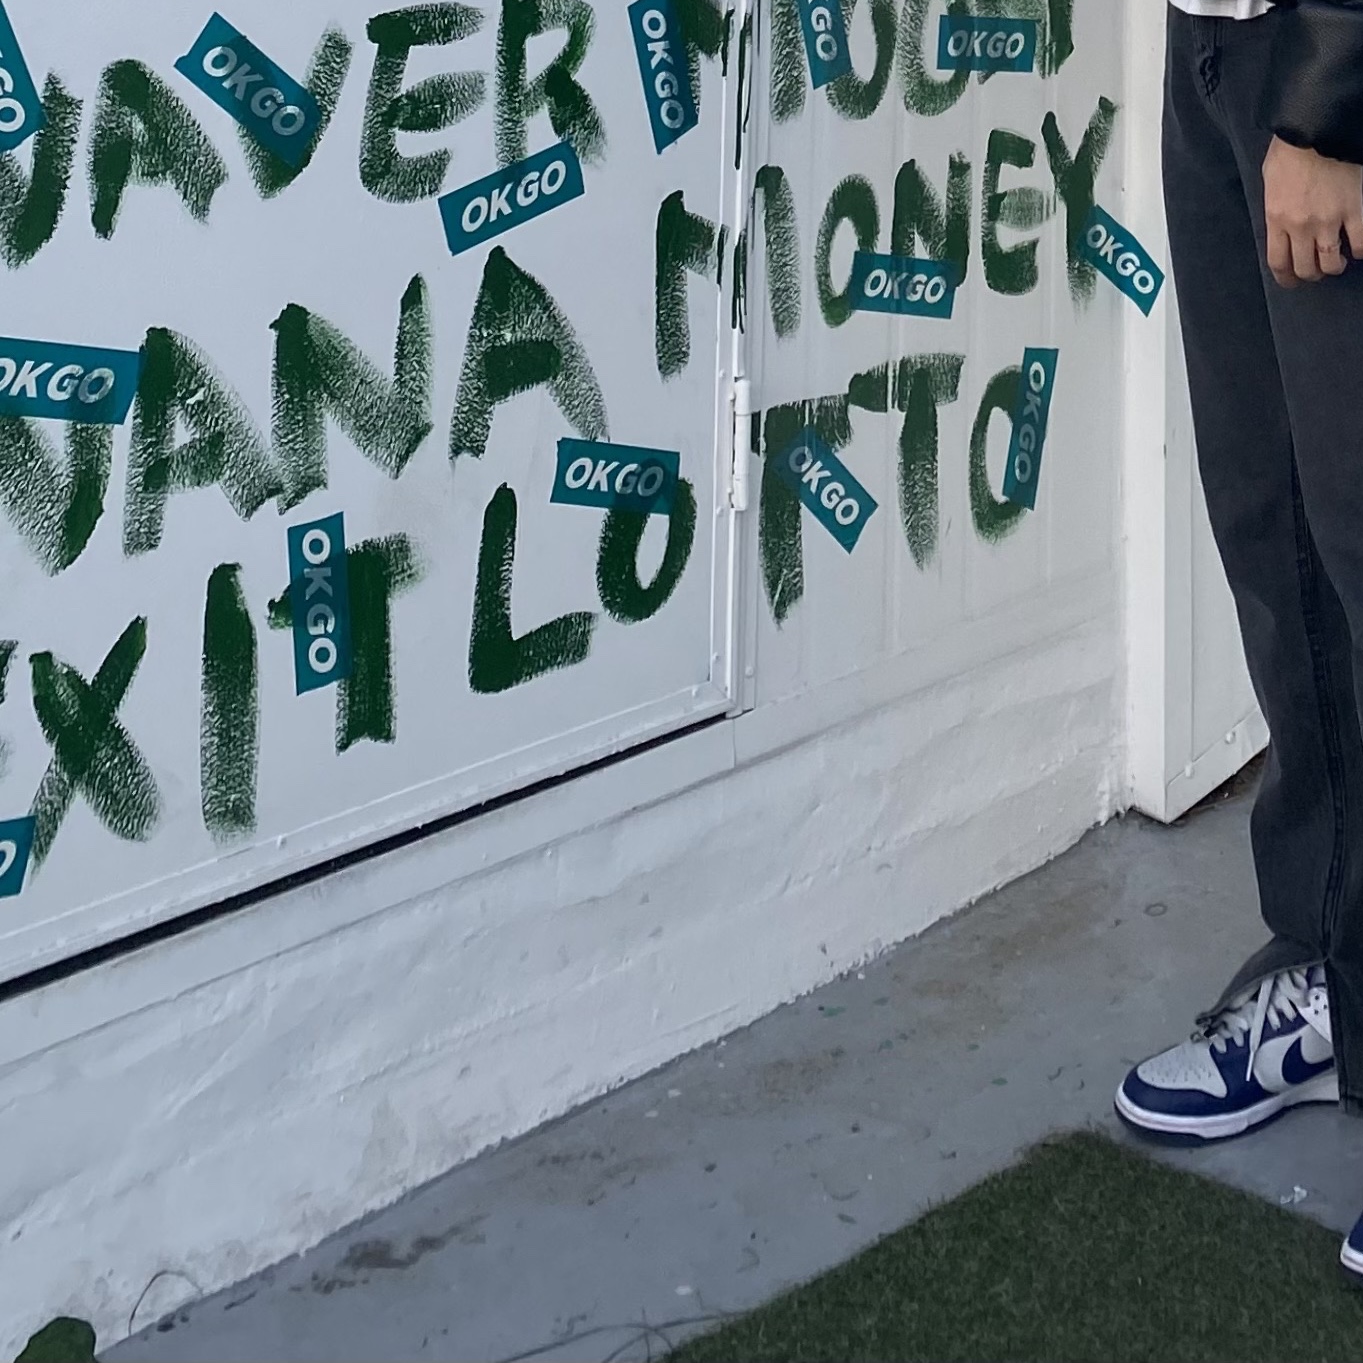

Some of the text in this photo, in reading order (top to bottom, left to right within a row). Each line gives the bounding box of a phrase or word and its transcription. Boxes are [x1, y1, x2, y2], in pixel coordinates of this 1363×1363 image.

[642, 9, 684, 130] OKGO
[947, 32, 1024, 59] OKGO
[202, 46, 305, 136] OKGO
[461, 162, 567, 232] OKGO
[864, 268, 946, 303] OKGO
[1084, 224, 1156, 296] OKGO
[1015, 362, 1045, 483] OKGO
[564, 456, 664, 497] OKGO
[789, 446, 859, 525] OKGO
[301, 529, 337, 674] OKGO
